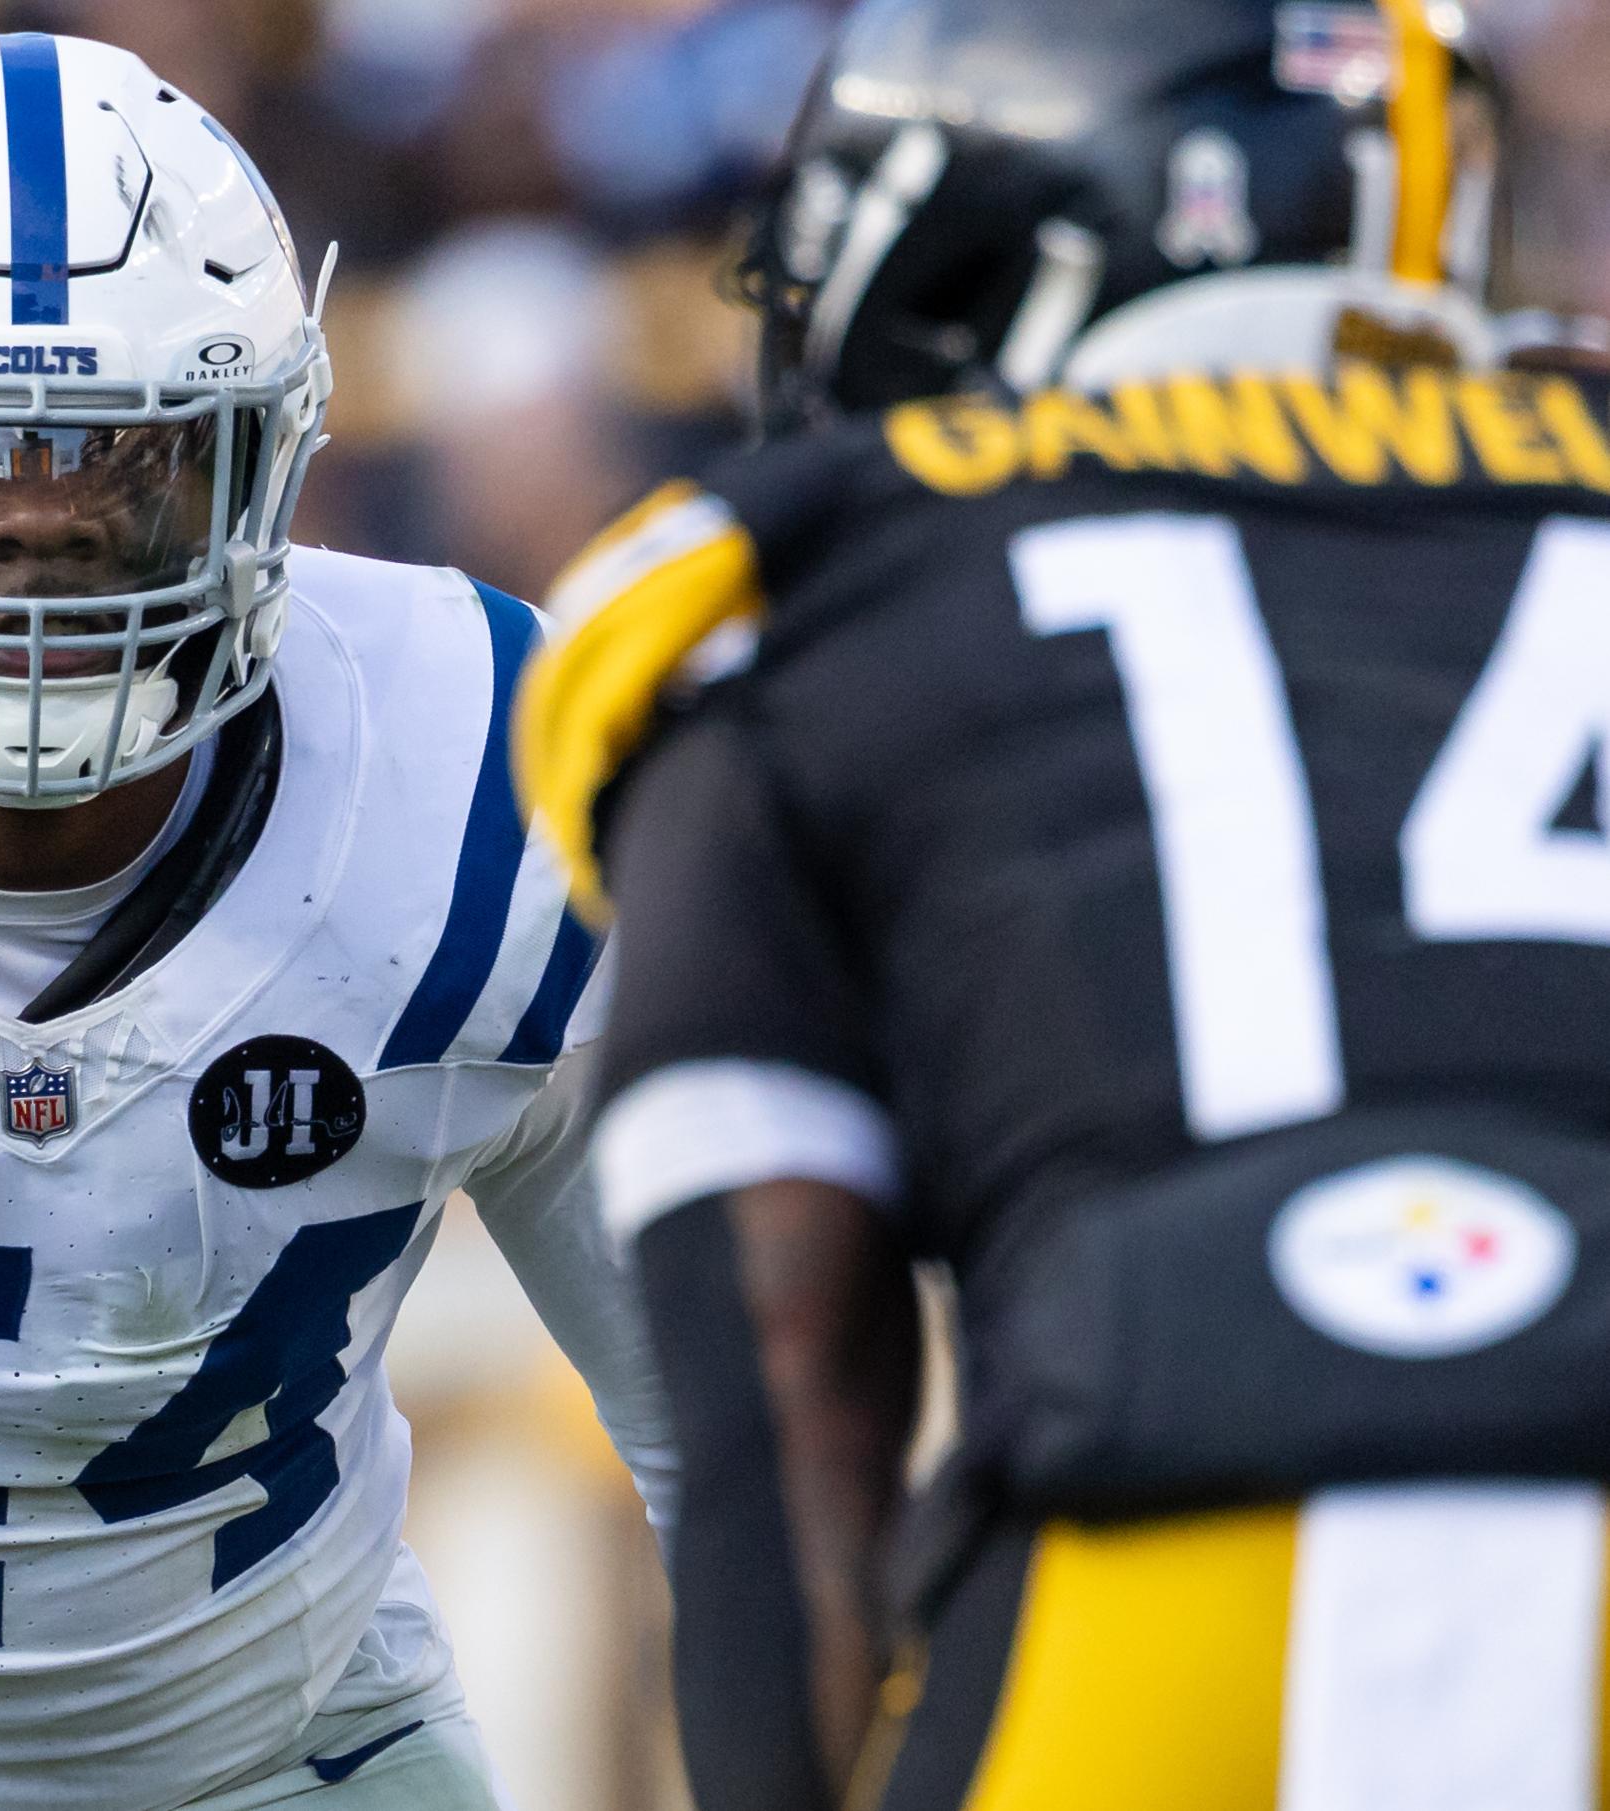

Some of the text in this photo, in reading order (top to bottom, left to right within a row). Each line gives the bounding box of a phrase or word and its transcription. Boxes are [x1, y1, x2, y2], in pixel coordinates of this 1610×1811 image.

[185, 364, 252, 382] OAKLEY
[1007, 509, 1610, 1144] 14
[13, 1097, 65, 1132] NFL
[220, 1069, 321, 1161] JI
